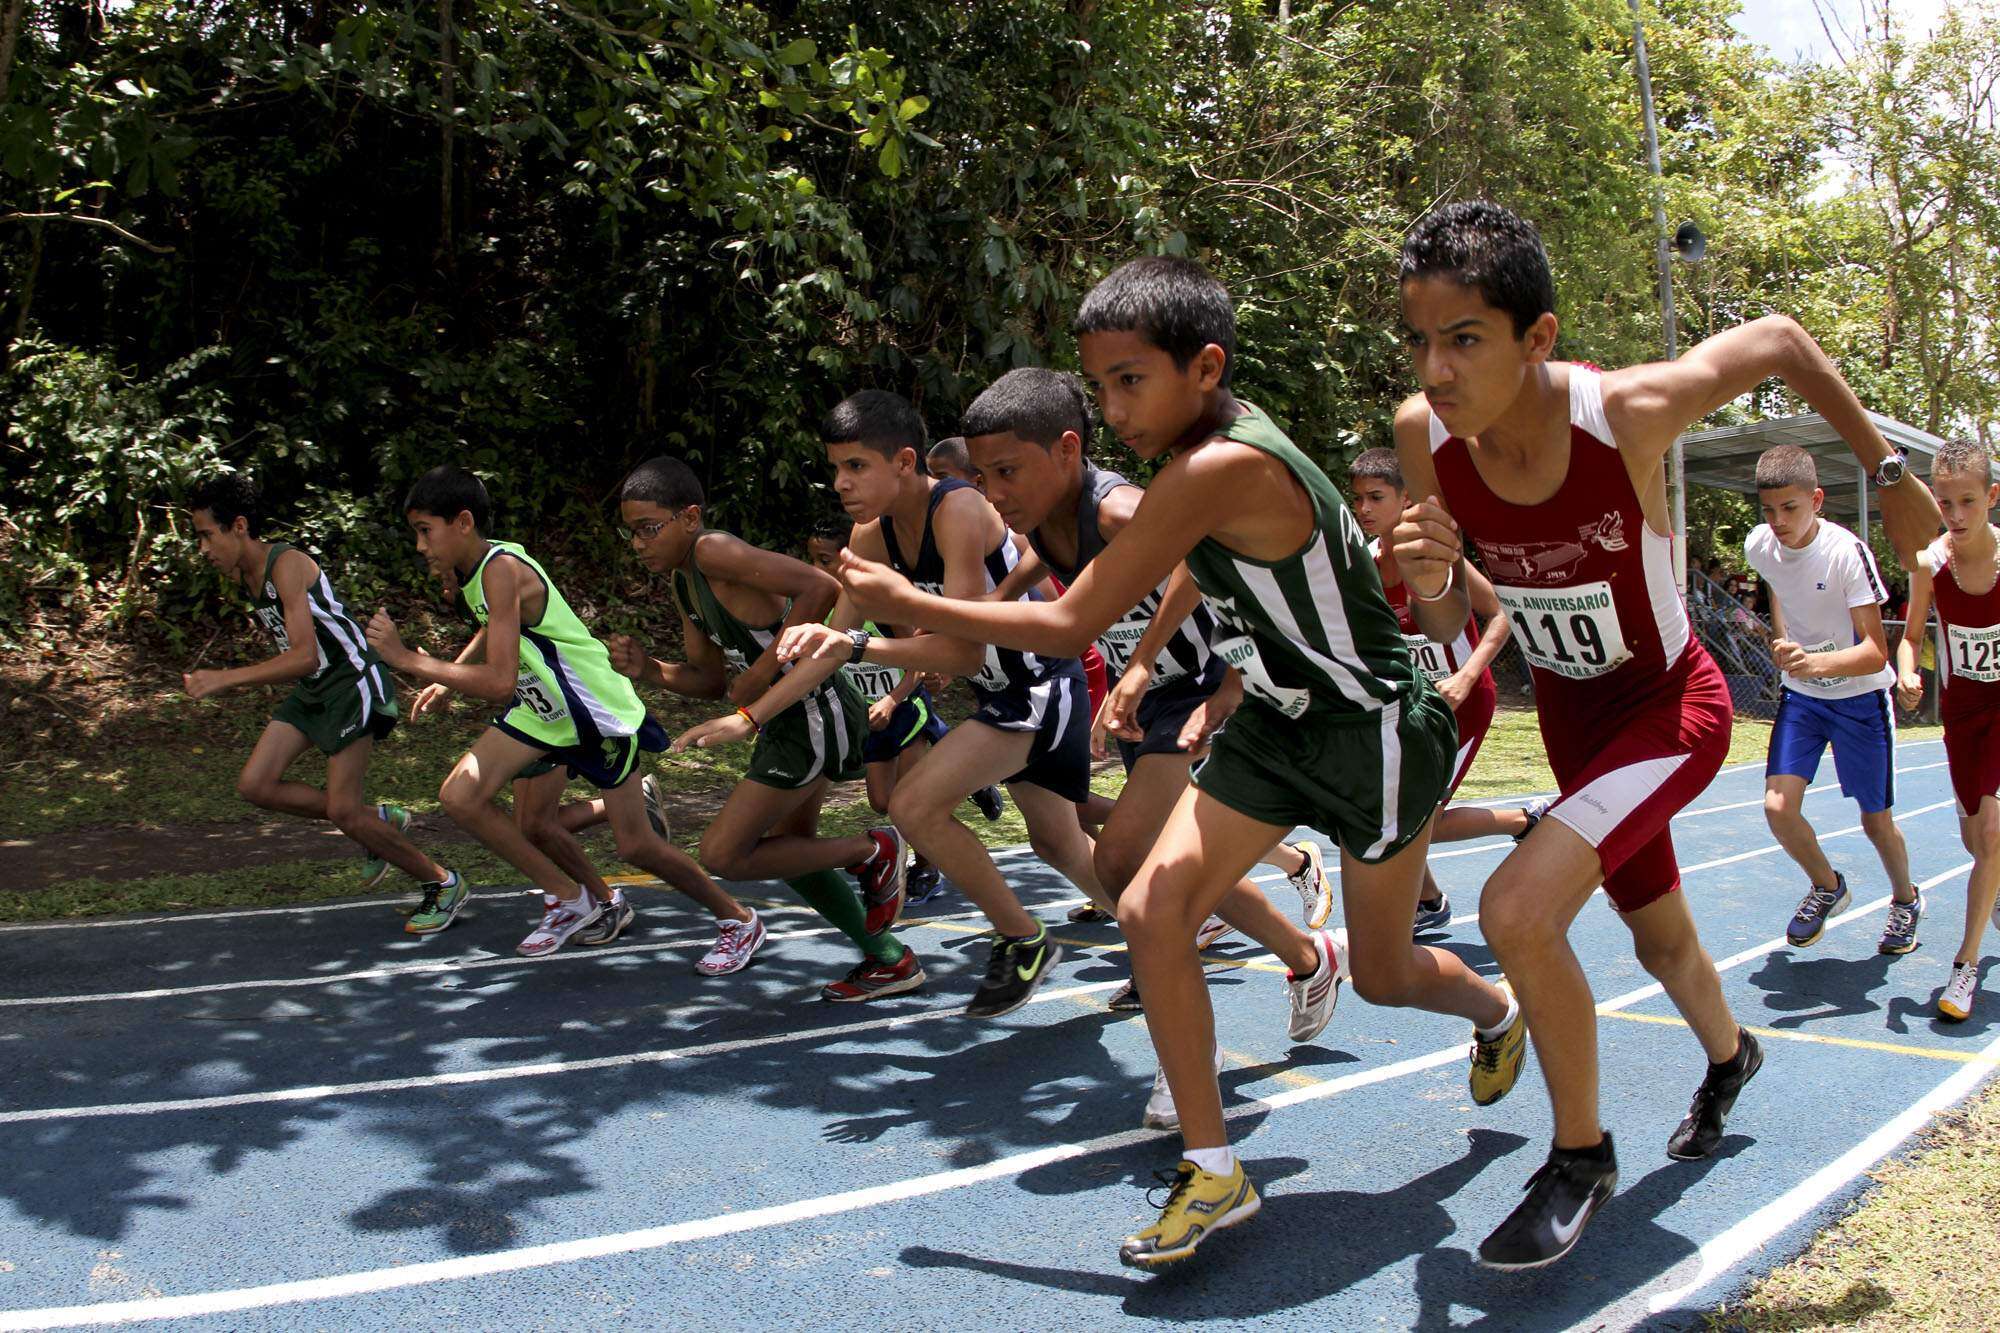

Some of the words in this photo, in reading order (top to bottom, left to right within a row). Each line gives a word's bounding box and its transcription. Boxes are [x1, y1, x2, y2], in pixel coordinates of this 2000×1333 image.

[1523, 591, 1610, 611] ANIVERSARIO
[1511, 610, 1607, 666] 119
[1408, 645, 1439, 672] 20
[853, 670, 894, 695] 070
[515, 686, 553, 714] 63
